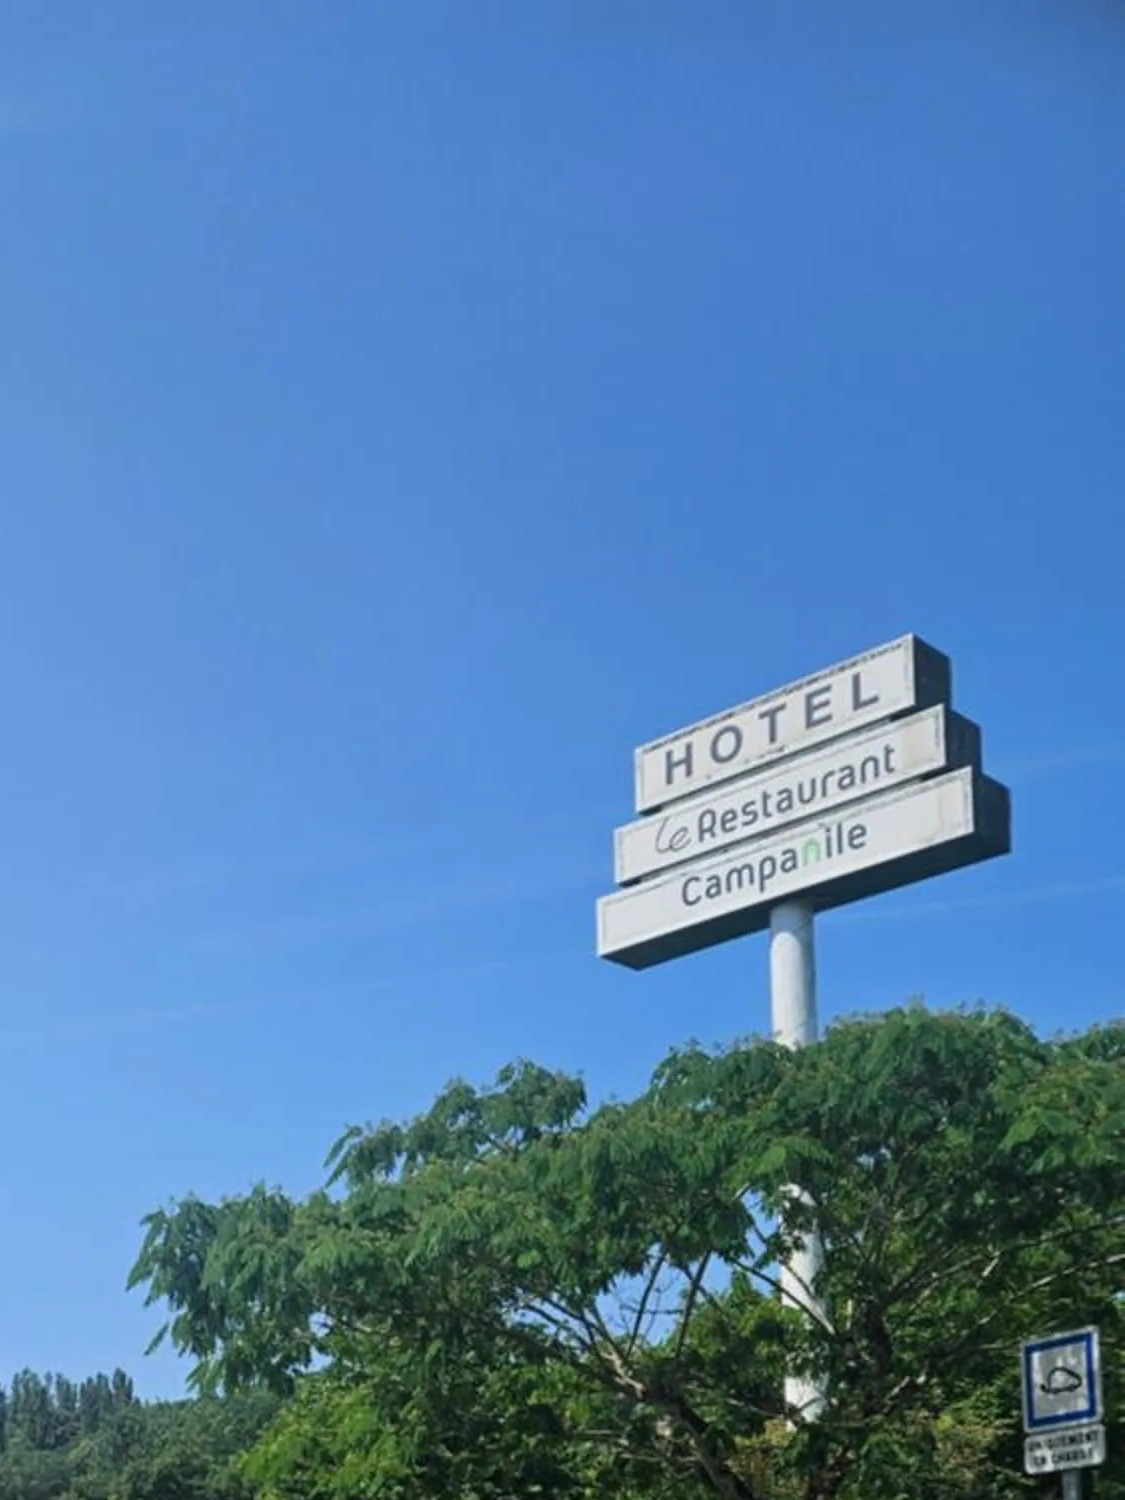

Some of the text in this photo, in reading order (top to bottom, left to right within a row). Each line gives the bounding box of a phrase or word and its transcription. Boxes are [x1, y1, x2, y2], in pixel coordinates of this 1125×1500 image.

[664, 672, 879, 786] HOTEL
[697, 742, 896, 844] Restaurant
[681, 819, 868, 907] Campanile
